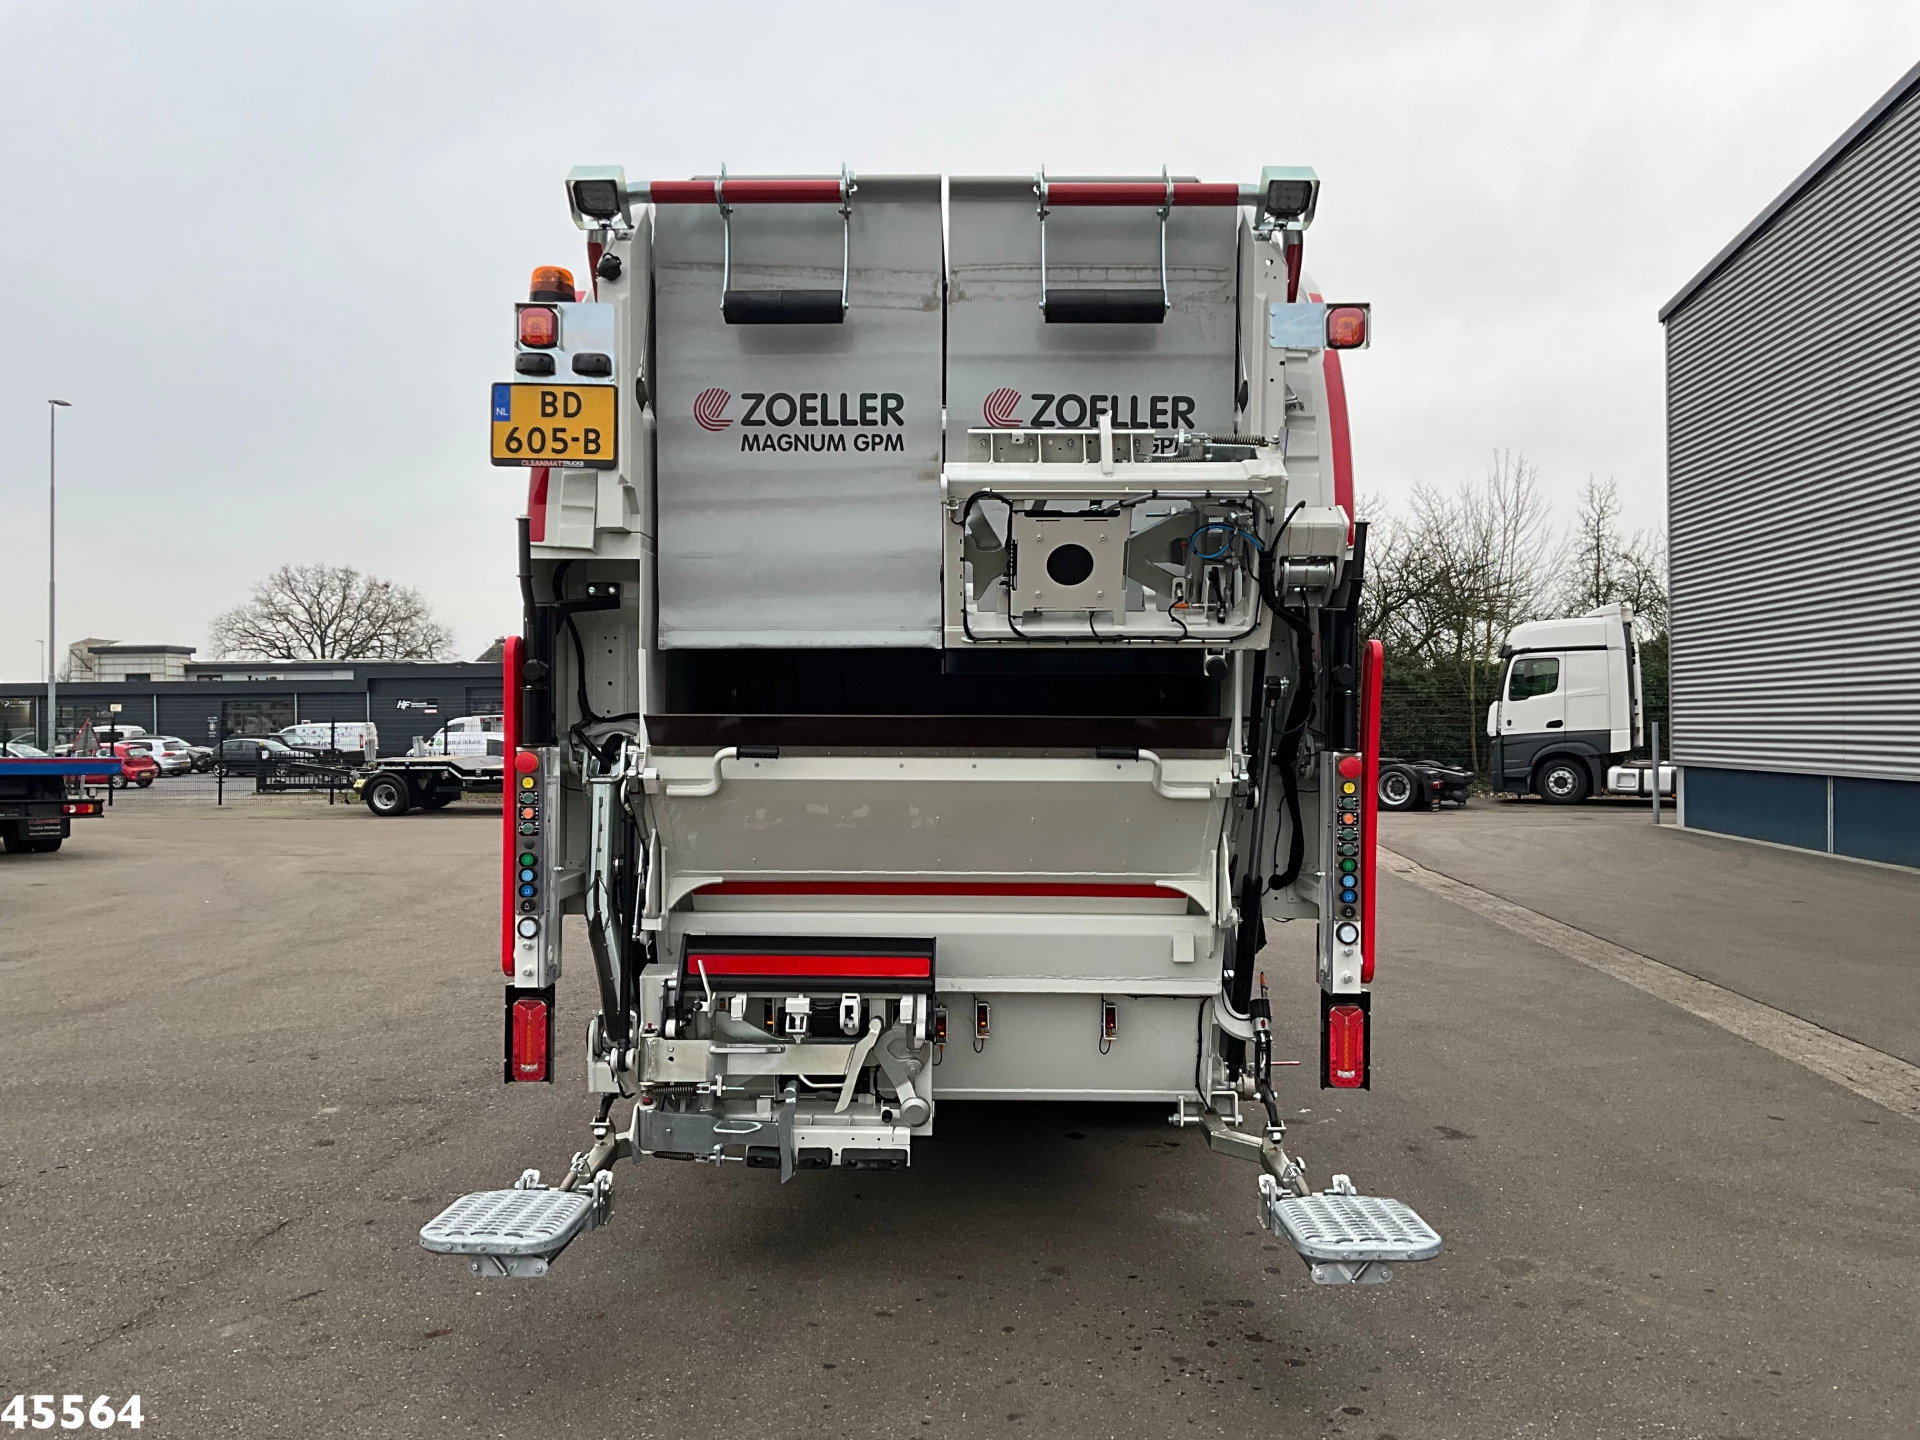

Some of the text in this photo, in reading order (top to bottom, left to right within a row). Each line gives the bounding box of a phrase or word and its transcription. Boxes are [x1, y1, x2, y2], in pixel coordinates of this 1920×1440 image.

[496, 407, 509, 416] NL
[541, 391, 582, 418] BD
[741, 393, 904, 427] ZOELLER
[1030, 394, 1195, 429] ZOELLER
[505, 427, 601, 454] 605-B
[741, 433, 904, 452] MAGNUM GPM
